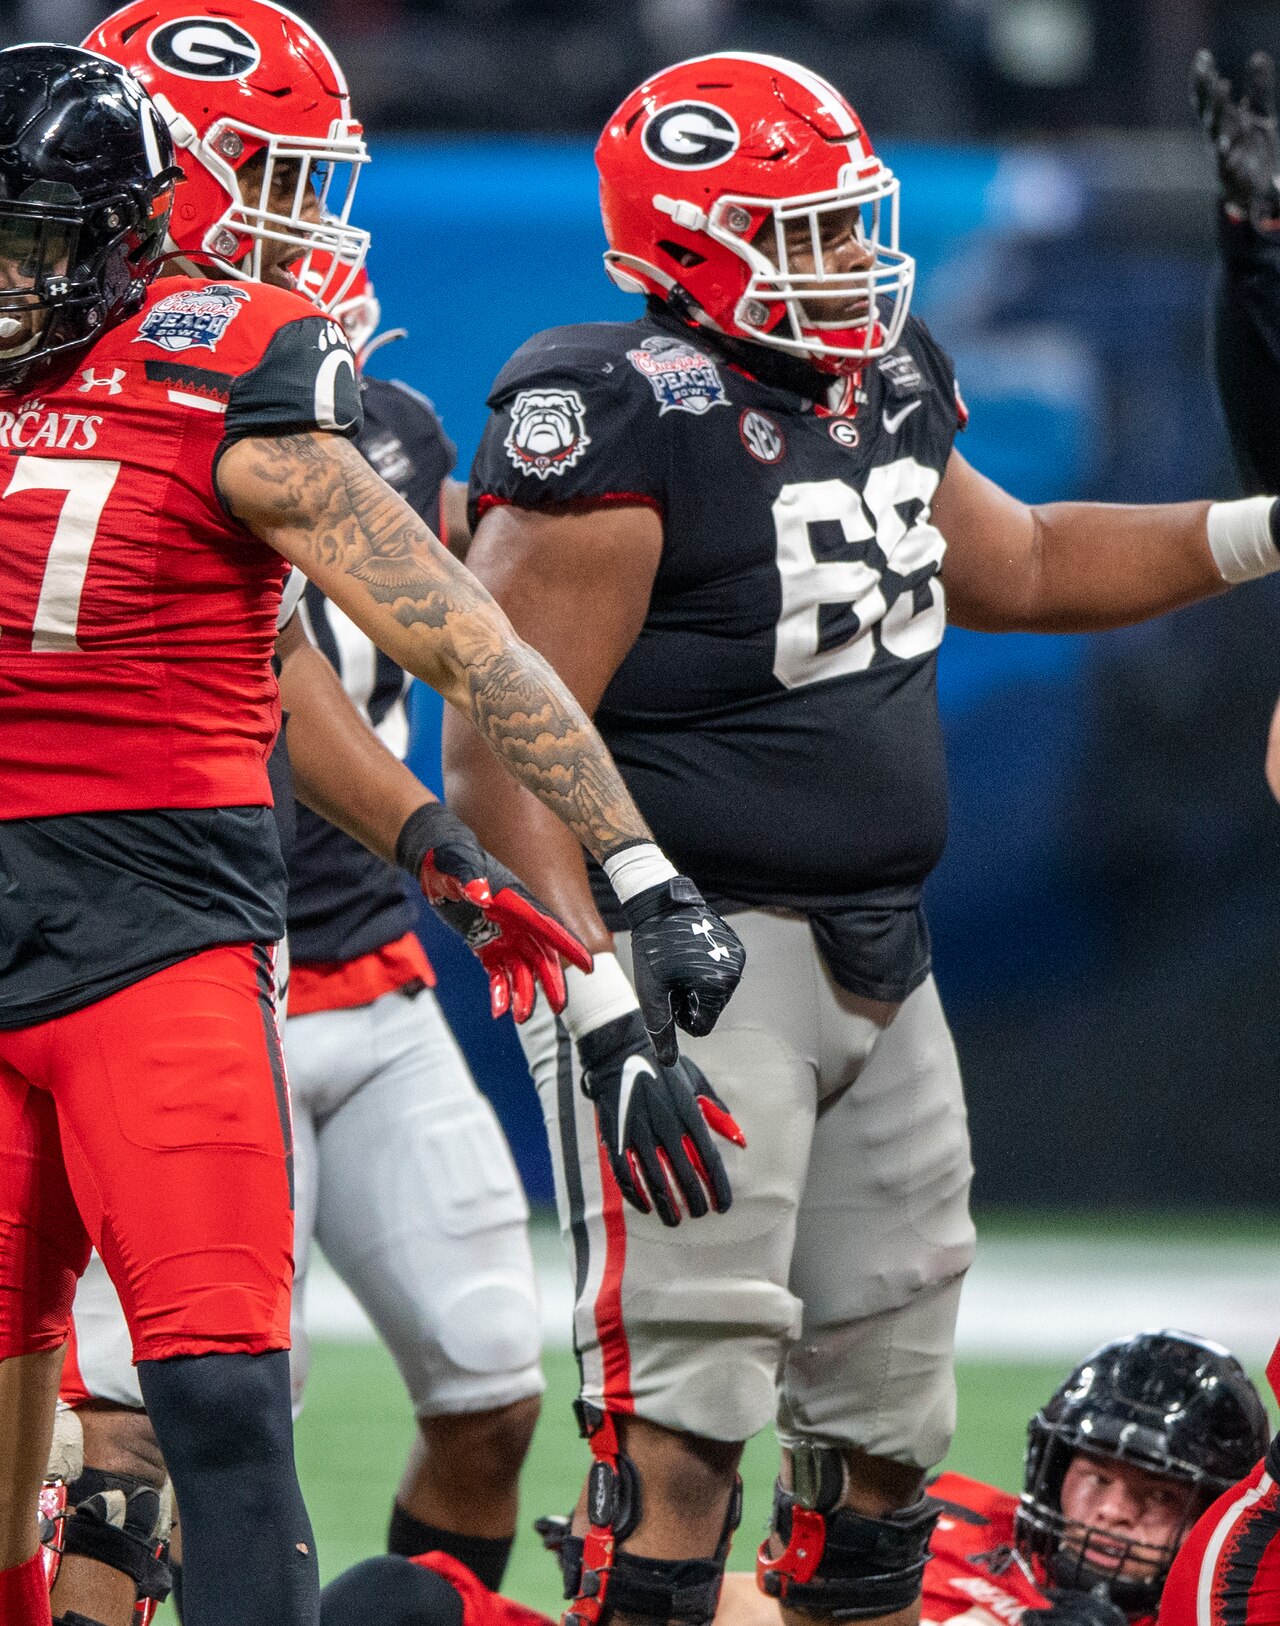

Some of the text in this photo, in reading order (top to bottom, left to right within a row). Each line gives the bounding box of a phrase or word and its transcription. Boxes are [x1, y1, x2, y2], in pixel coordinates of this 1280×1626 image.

[151, 18, 258, 78] G
[644, 103, 737, 166] G
[142, 311, 228, 336] PEACH
[155, 328, 202, 339] BOWL
[651, 368, 719, 396] PEACH
[673, 387, 711, 400] BOWL
[742, 411, 782, 461] SEC
[832, 423, 858, 445] G
[772, 457, 948, 690] 69
